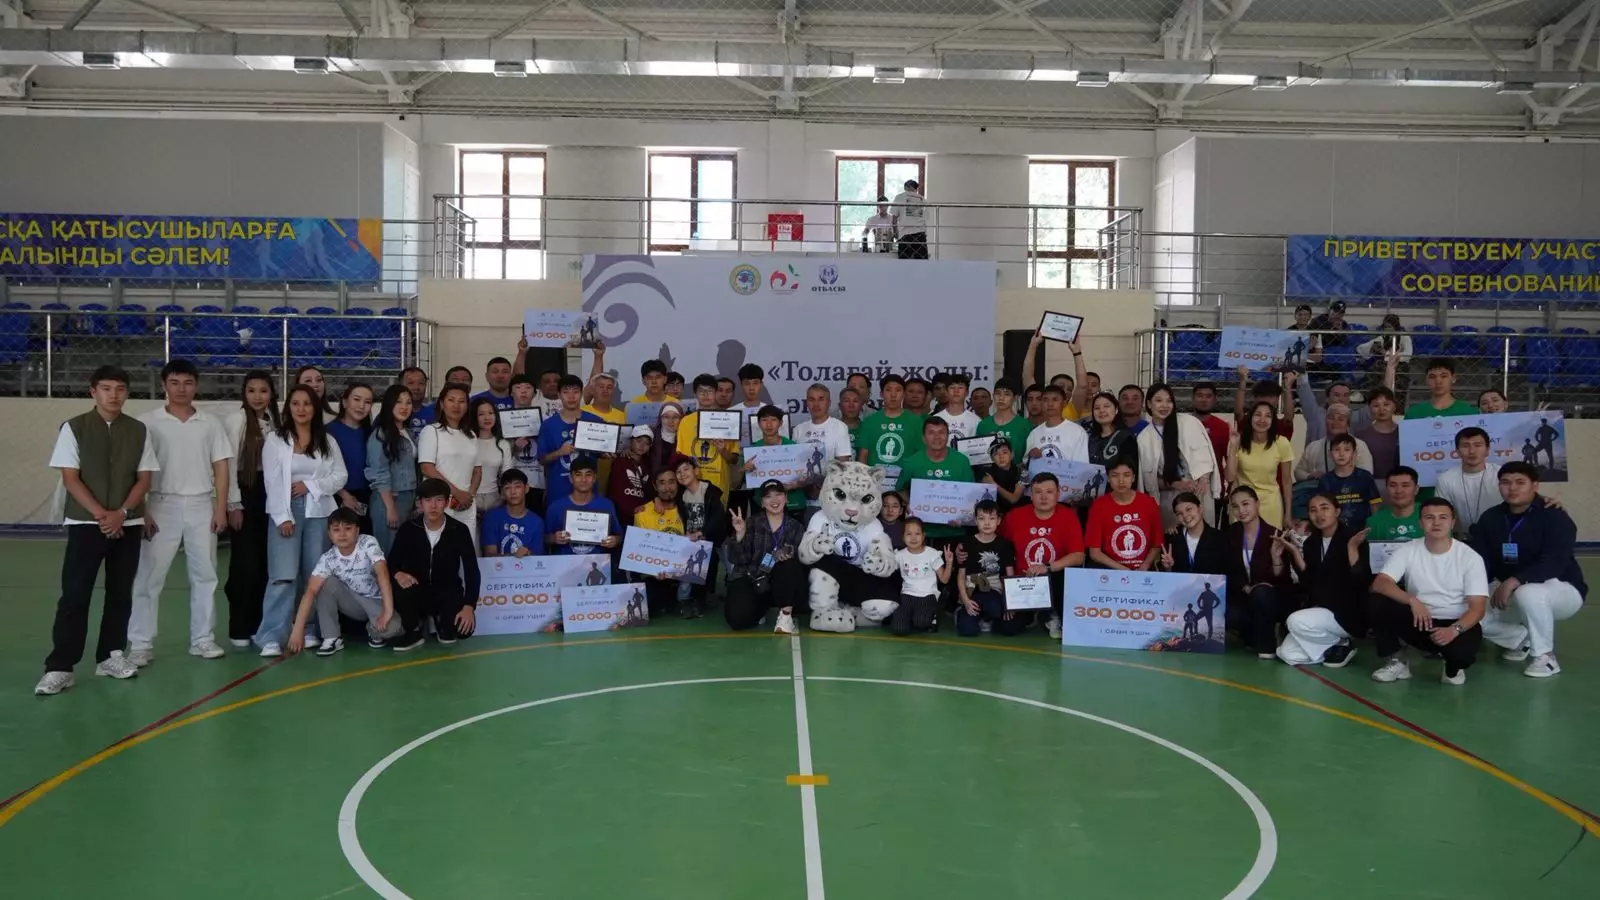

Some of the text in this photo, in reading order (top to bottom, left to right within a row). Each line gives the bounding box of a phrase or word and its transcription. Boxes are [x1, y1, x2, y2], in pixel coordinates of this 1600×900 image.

[52, 221, 296, 241] ҚАТЫСУШЫЛАРҒА
[1324, 240, 1522, 260] ПРИВЕТСТВУЕМ
[131, 246, 230, 266] СӘЛЕМ!
[1243, 352, 1268, 361] 000
[1414, 451, 1445, 462] 100
[768, 468, 792, 477] 000
[914, 504, 930, 512] 40
[933, 505, 957, 514] 000
[627, 552, 642, 562] 40
[644, 556, 670, 568] 000
[486, 581, 556, 590] СЕРТИФИКАТ
[512, 593, 548, 605] 000
[1090, 596, 1165, 606] СЕРТИФИКАТ
[568, 612, 585, 622] 40
[588, 611, 612, 620] 000
[1074, 606, 1112, 618] 300
[1116, 608, 1156, 621] 000
